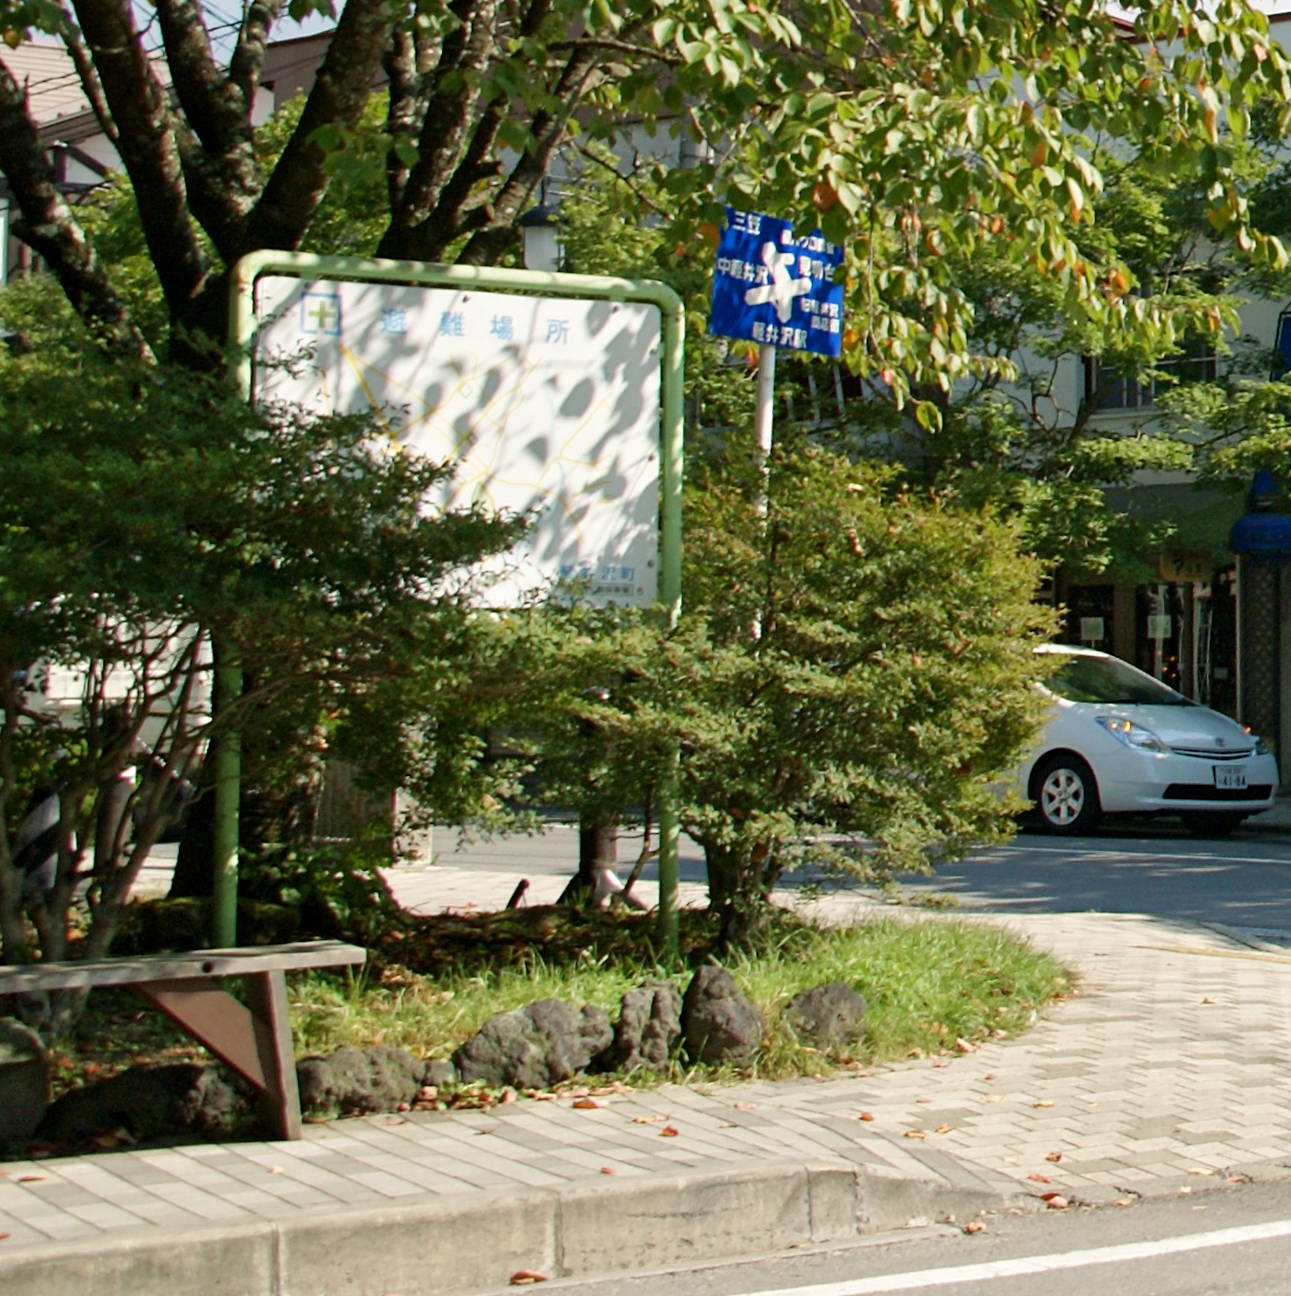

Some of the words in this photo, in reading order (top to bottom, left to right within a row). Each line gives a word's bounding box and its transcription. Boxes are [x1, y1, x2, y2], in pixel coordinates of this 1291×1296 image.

[717, 257, 769, 285] 中軽井沢
[379, 307, 571, 345] 避難場所
[752, 320, 808, 349] 軽井沢駅
